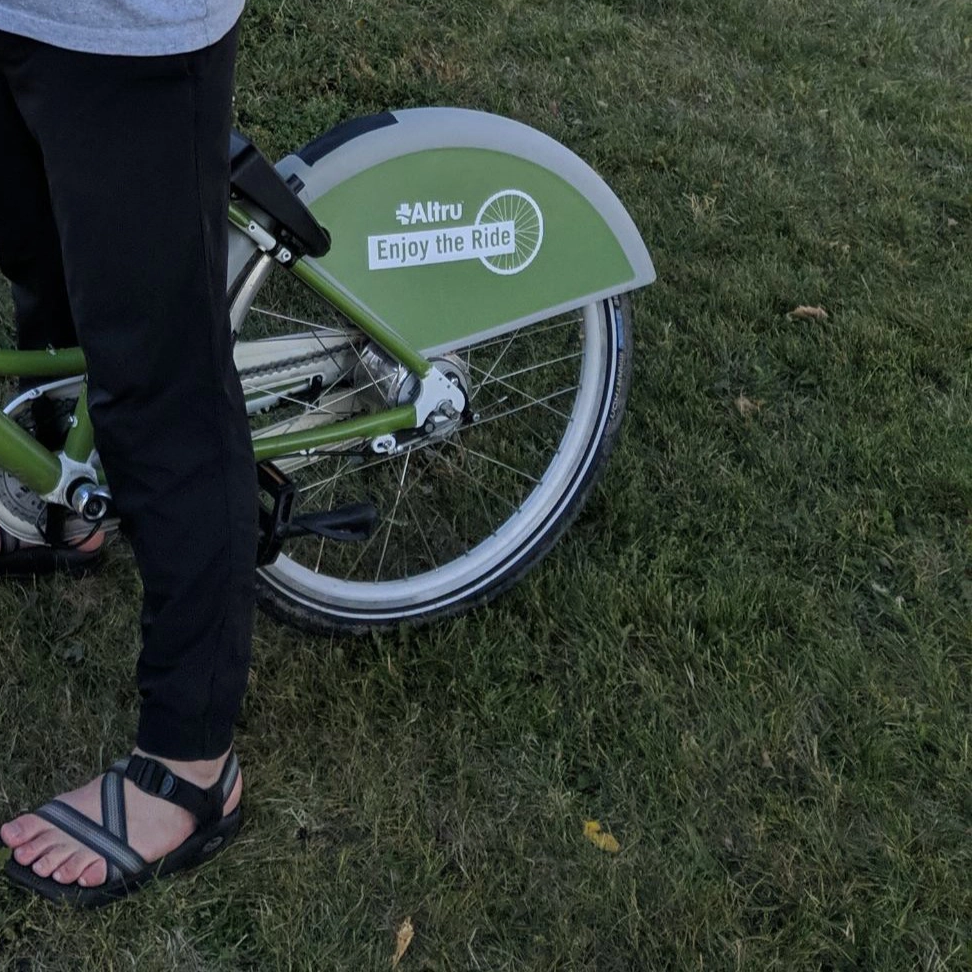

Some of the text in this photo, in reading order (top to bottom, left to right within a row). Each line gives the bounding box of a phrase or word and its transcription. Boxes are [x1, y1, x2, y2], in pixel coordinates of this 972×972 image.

[411, 201, 462, 224] Altru
[377, 227, 511, 263] Enjoy the Ride
